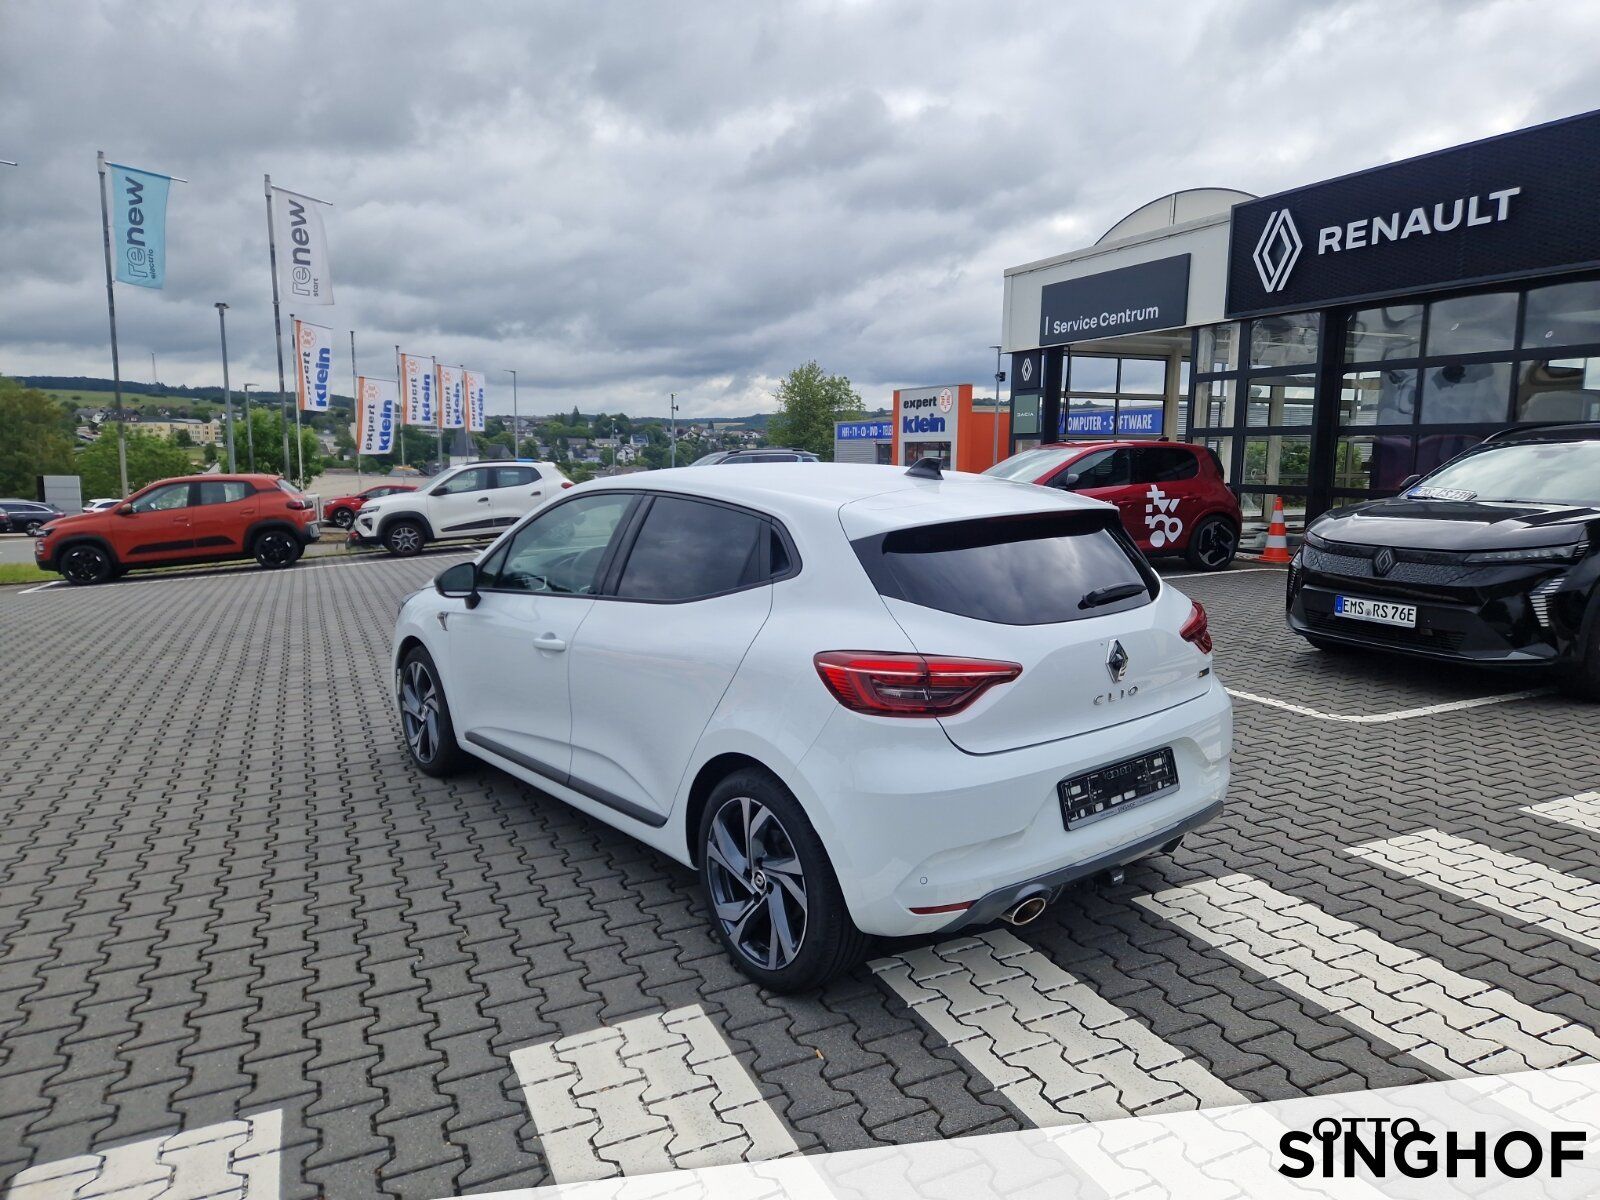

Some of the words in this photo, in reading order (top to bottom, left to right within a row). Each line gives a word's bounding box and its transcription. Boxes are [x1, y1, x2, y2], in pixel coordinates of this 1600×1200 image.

[125, 176, 148, 280] renew
[1318, 186, 1521, 255] RENAULT
[148, 248, 156, 280] electric
[287, 198, 311, 297] renew
[1053, 315, 1098, 335] Service
[1099, 305, 1160, 328] Centrum
[314, 347, 331, 407] klein
[411, 376, 419, 421] expert
[422, 374, 431, 422] klein
[378, 399, 393, 451] klein
[902, 413, 946, 434] klein
[903, 395, 938, 410] expert
[1063, 415, 1102, 432] OMPUTER
[1109, 413, 1153, 431] SFTWARE
[365, 404, 376, 451] expert
[1343, 598, 1365, 615] EMS
[1372, 603, 1389, 619] RS
[1391, 606, 1415, 623] 76E
[1092, 685, 1139, 706] CLIO
